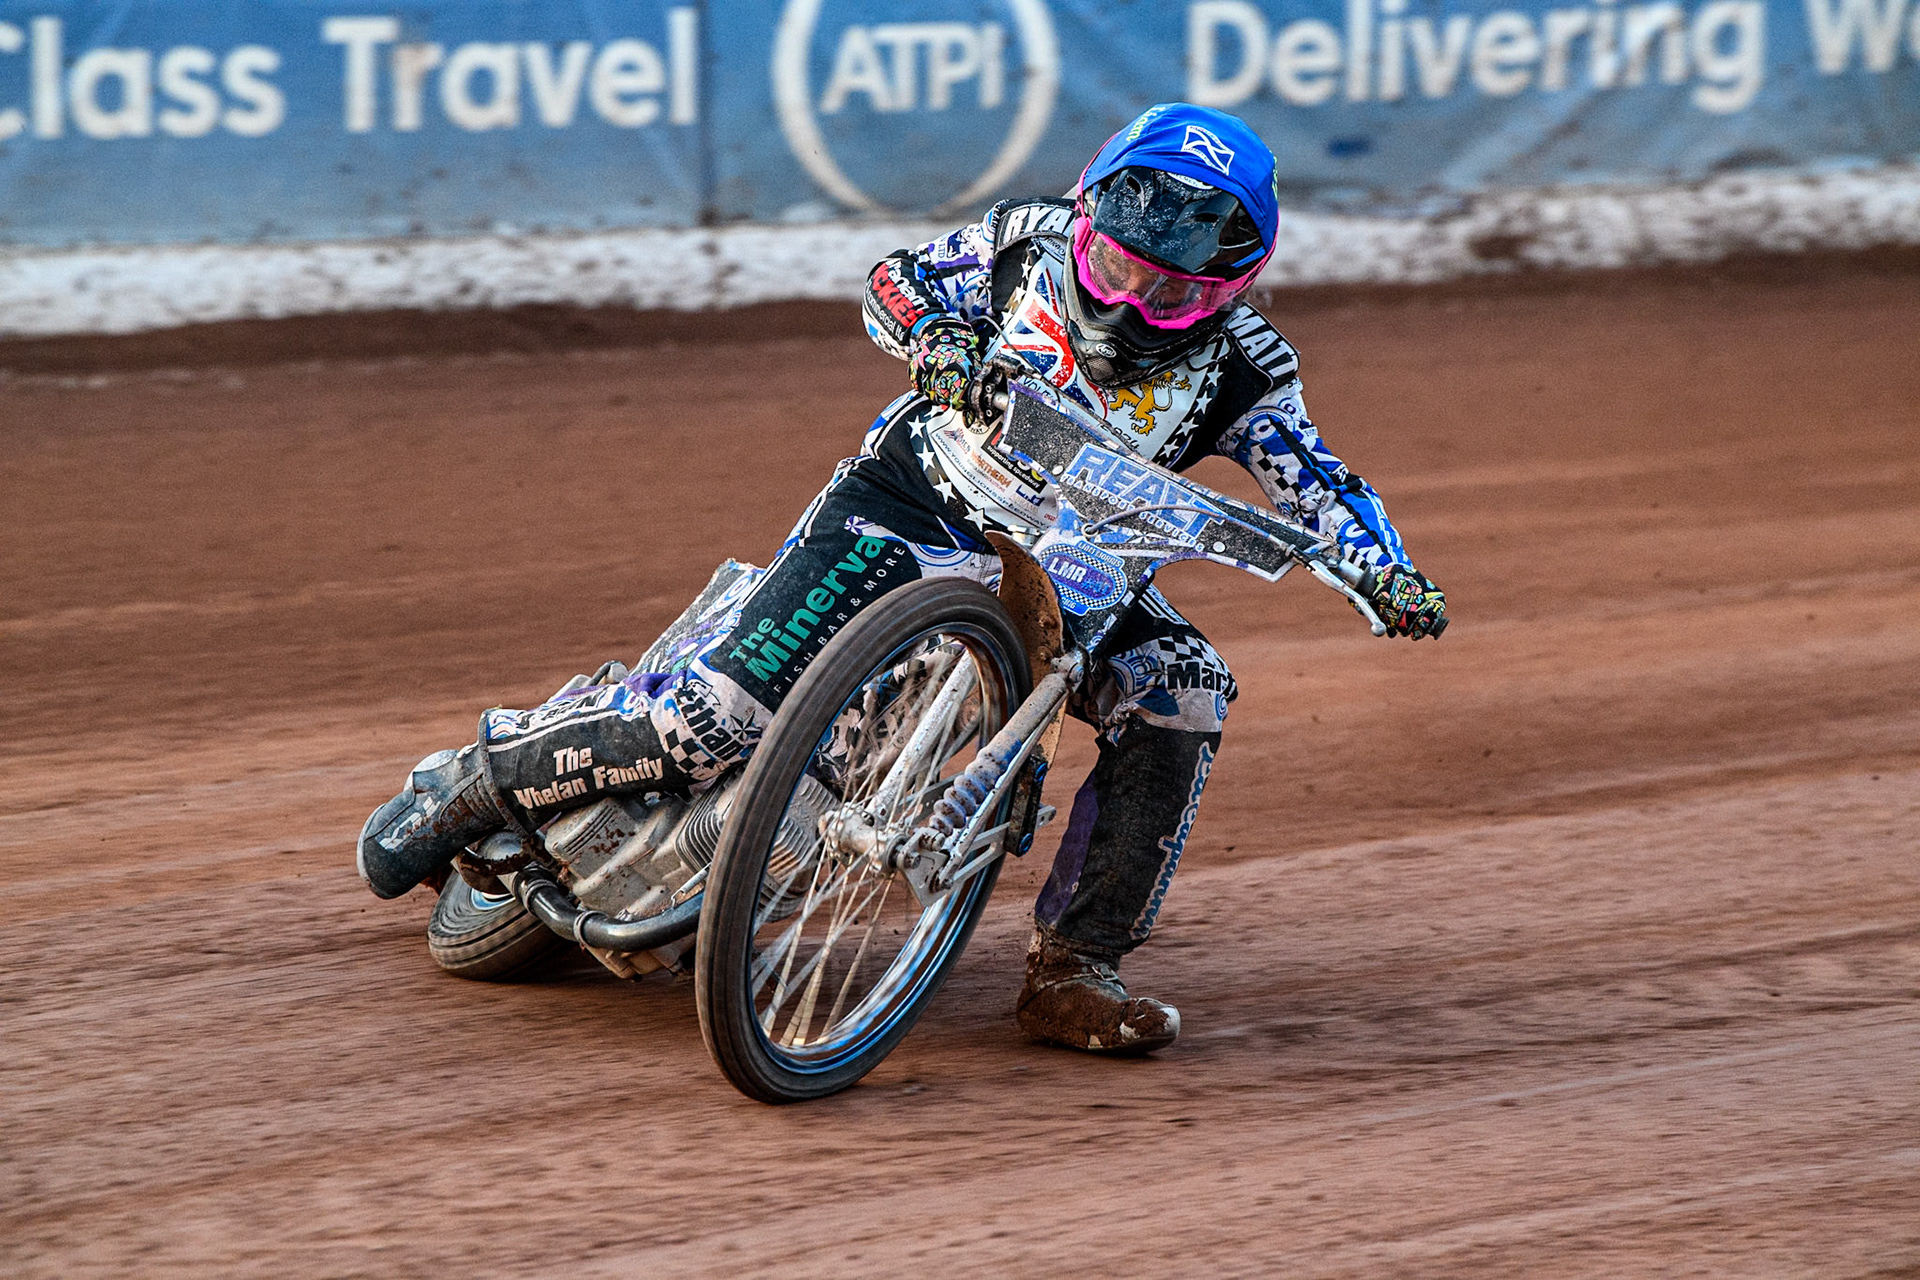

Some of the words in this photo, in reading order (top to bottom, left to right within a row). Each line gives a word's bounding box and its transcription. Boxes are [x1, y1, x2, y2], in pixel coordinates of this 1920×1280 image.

[320, 6, 696, 132] Travel
[822, 21, 1001, 113] ATPI
[1187, 0, 1767, 113] Delivering
[1226, 305, 1299, 377] MATT
[986, 444, 1014, 471] supporting
[1060, 473, 1137, 512] TRANSPORT
[1138, 511, 1205, 553] SERVICES
[1047, 556, 1088, 583] LMR
[729, 617, 775, 661] The
[744, 535, 887, 682] Minerva
[773, 652, 815, 693] FISH
[817, 612, 849, 646] BAR
[850, 597, 862, 607] &
[863, 546, 906, 592] MORE
[552, 744, 594, 777] The
[591, 755, 665, 790] Family
